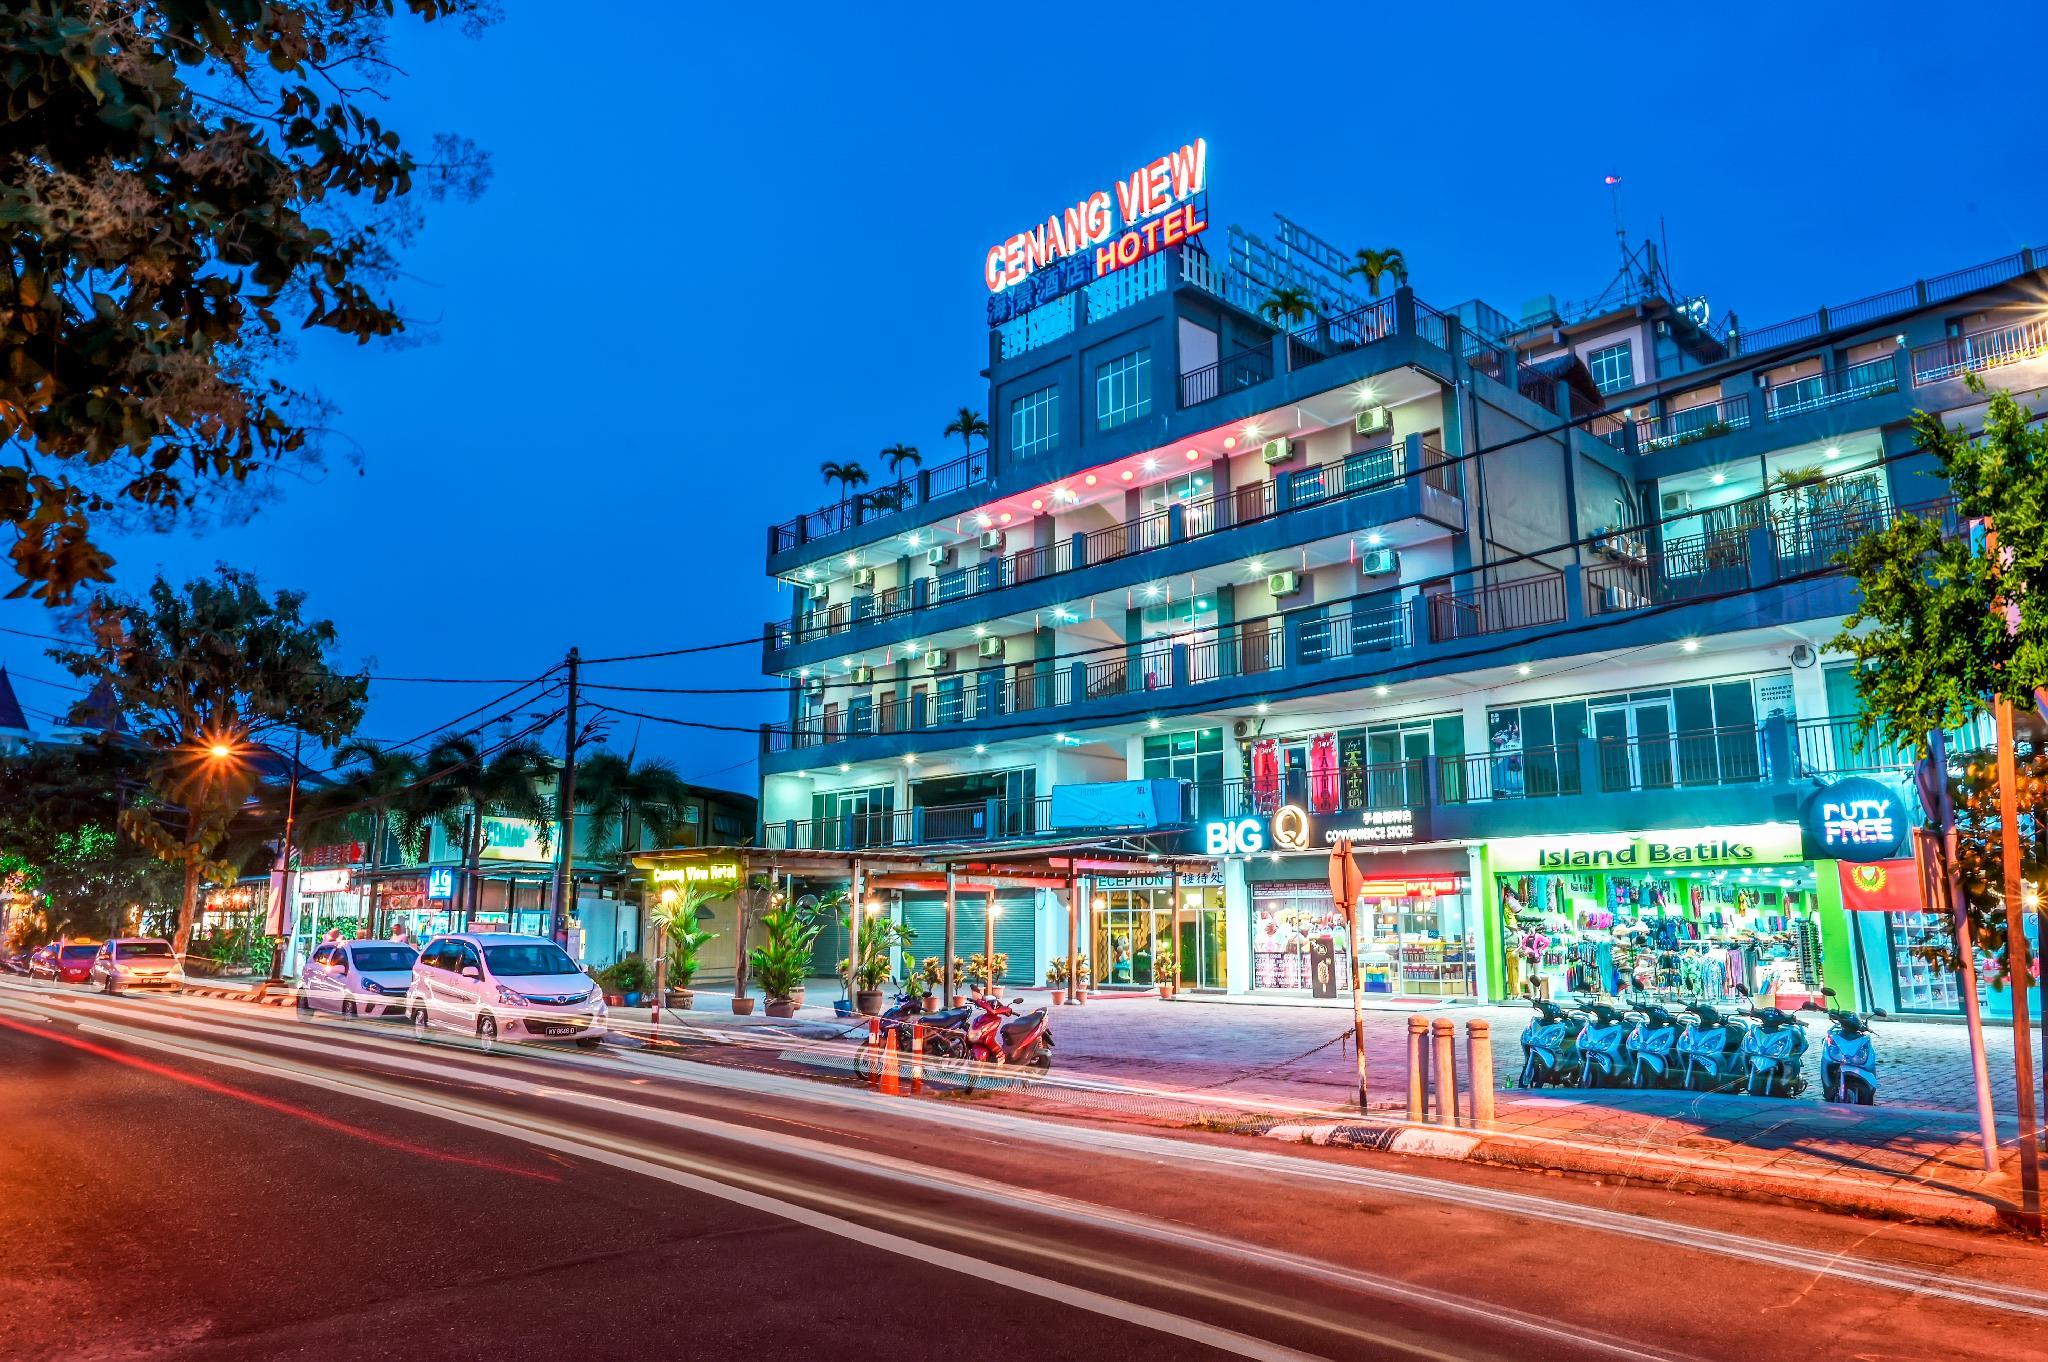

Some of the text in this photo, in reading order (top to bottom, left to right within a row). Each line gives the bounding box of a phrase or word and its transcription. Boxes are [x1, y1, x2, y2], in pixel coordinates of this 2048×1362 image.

[985, 138, 1206, 293] CENANG VIEW
[1096, 204, 1207, 277] HOTEL
[1206, 805, 1309, 855] BIG Q
[1325, 825, 1413, 843] CONVENIENCE STORE
[1824, 817, 1895, 845] FREE
[1539, 839, 1753, 866] Island Batiks
[435, 869, 450, 886] 16
[1097, 874, 1164, 887] ECEPTION
[1182, 872, 1224, 885] 接待处
